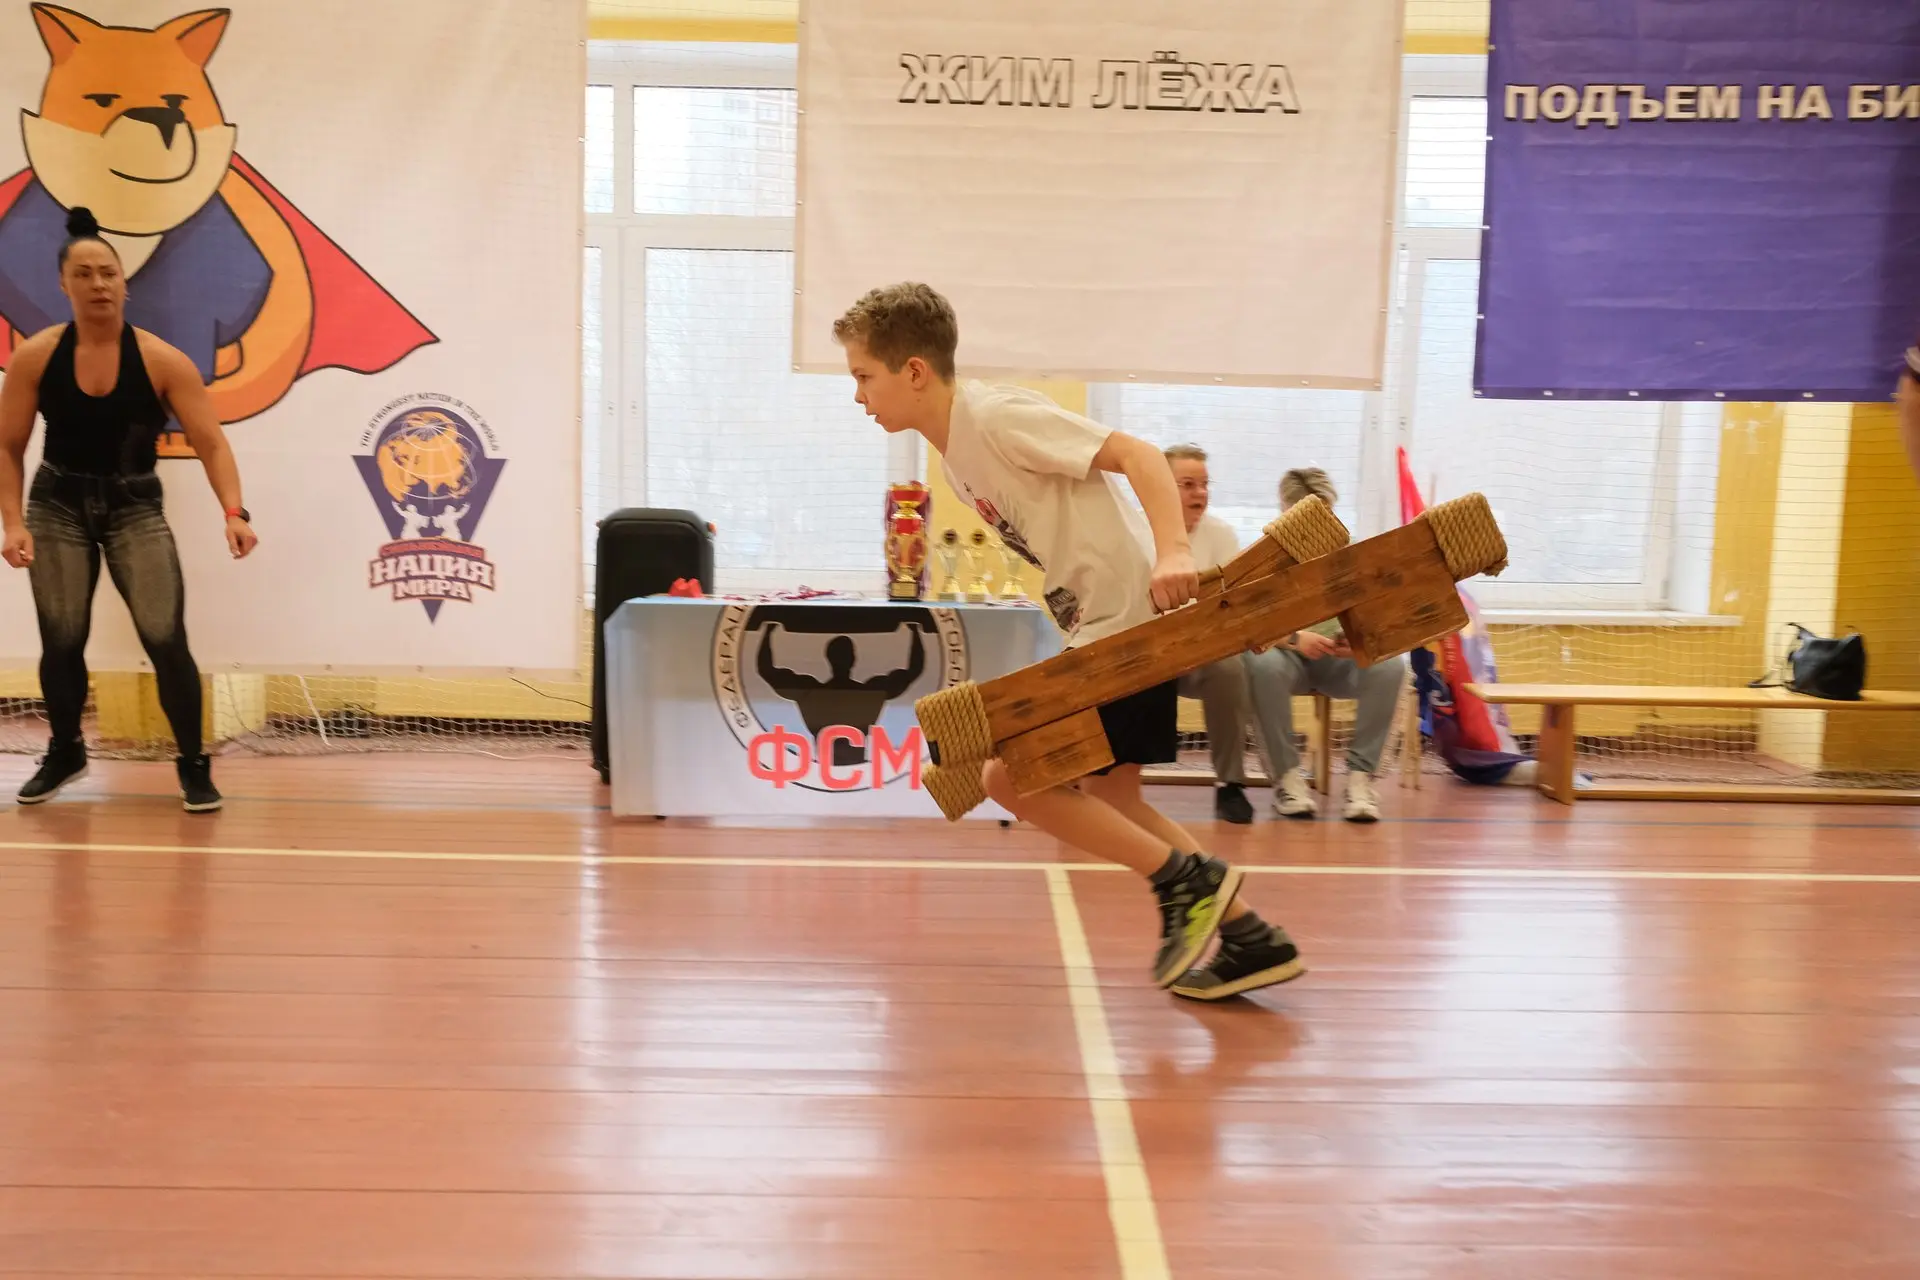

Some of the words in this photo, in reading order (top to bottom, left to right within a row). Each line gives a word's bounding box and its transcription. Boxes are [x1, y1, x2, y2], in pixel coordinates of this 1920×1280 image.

[898, 53, 1073, 108] ЖИМ
[1091, 50, 1300, 114] ЛЁЖА
[1504, 84, 1742, 129] ПОДЪЕМ
[1757, 84, 1834, 122] НА
[371, 553, 494, 588] НАЦИЯ
[393, 578, 472, 600] МИРА
[747, 724, 922, 790] ФСМ
